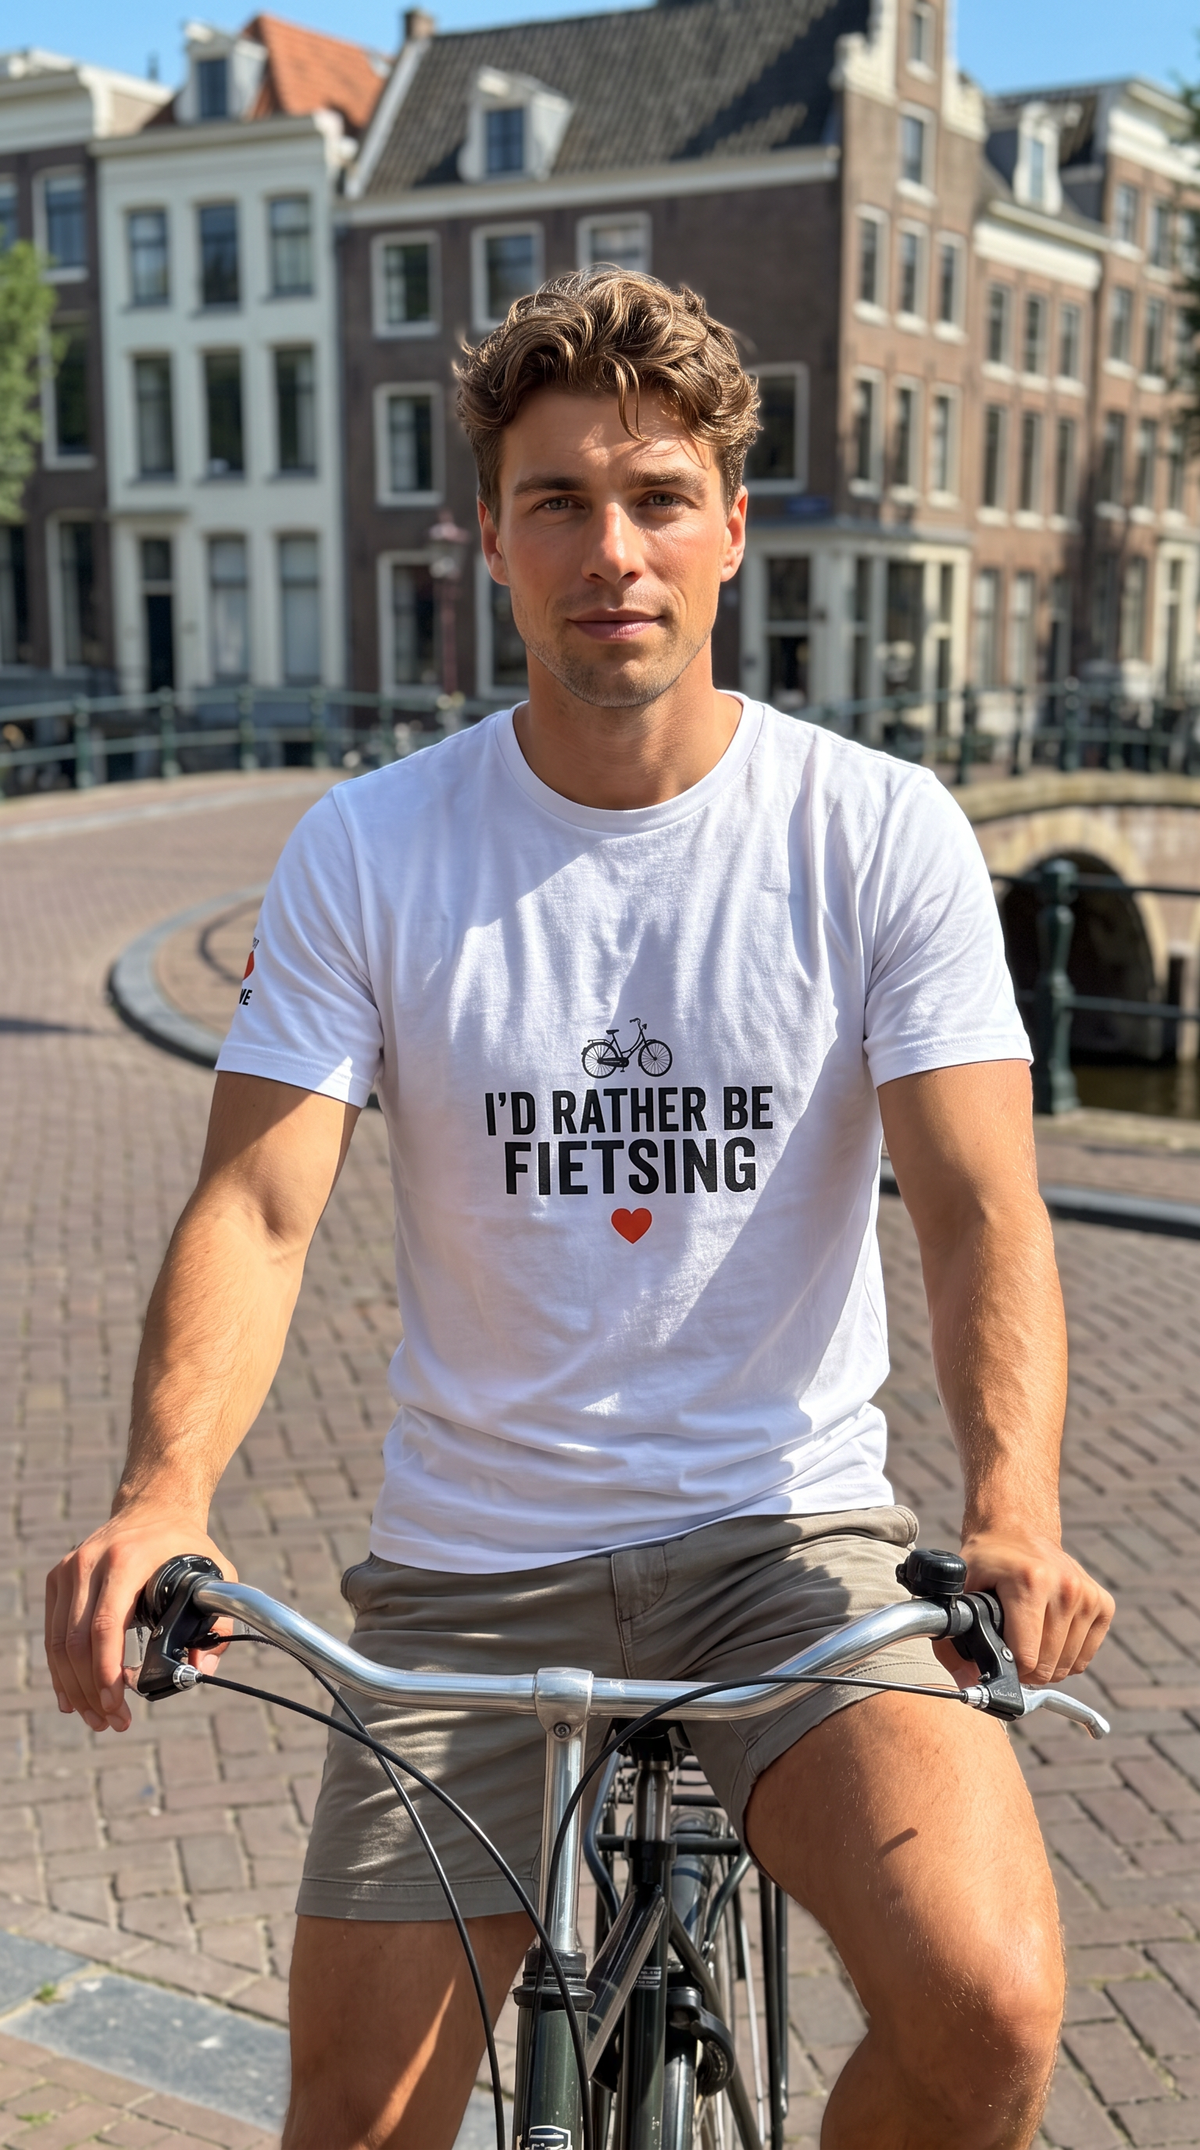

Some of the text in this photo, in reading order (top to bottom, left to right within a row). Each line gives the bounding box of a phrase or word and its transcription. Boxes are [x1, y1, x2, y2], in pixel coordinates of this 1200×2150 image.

[484, 1085, 774, 1136] I'D RATHER BE
[504, 1136, 756, 1196] FIETSING
